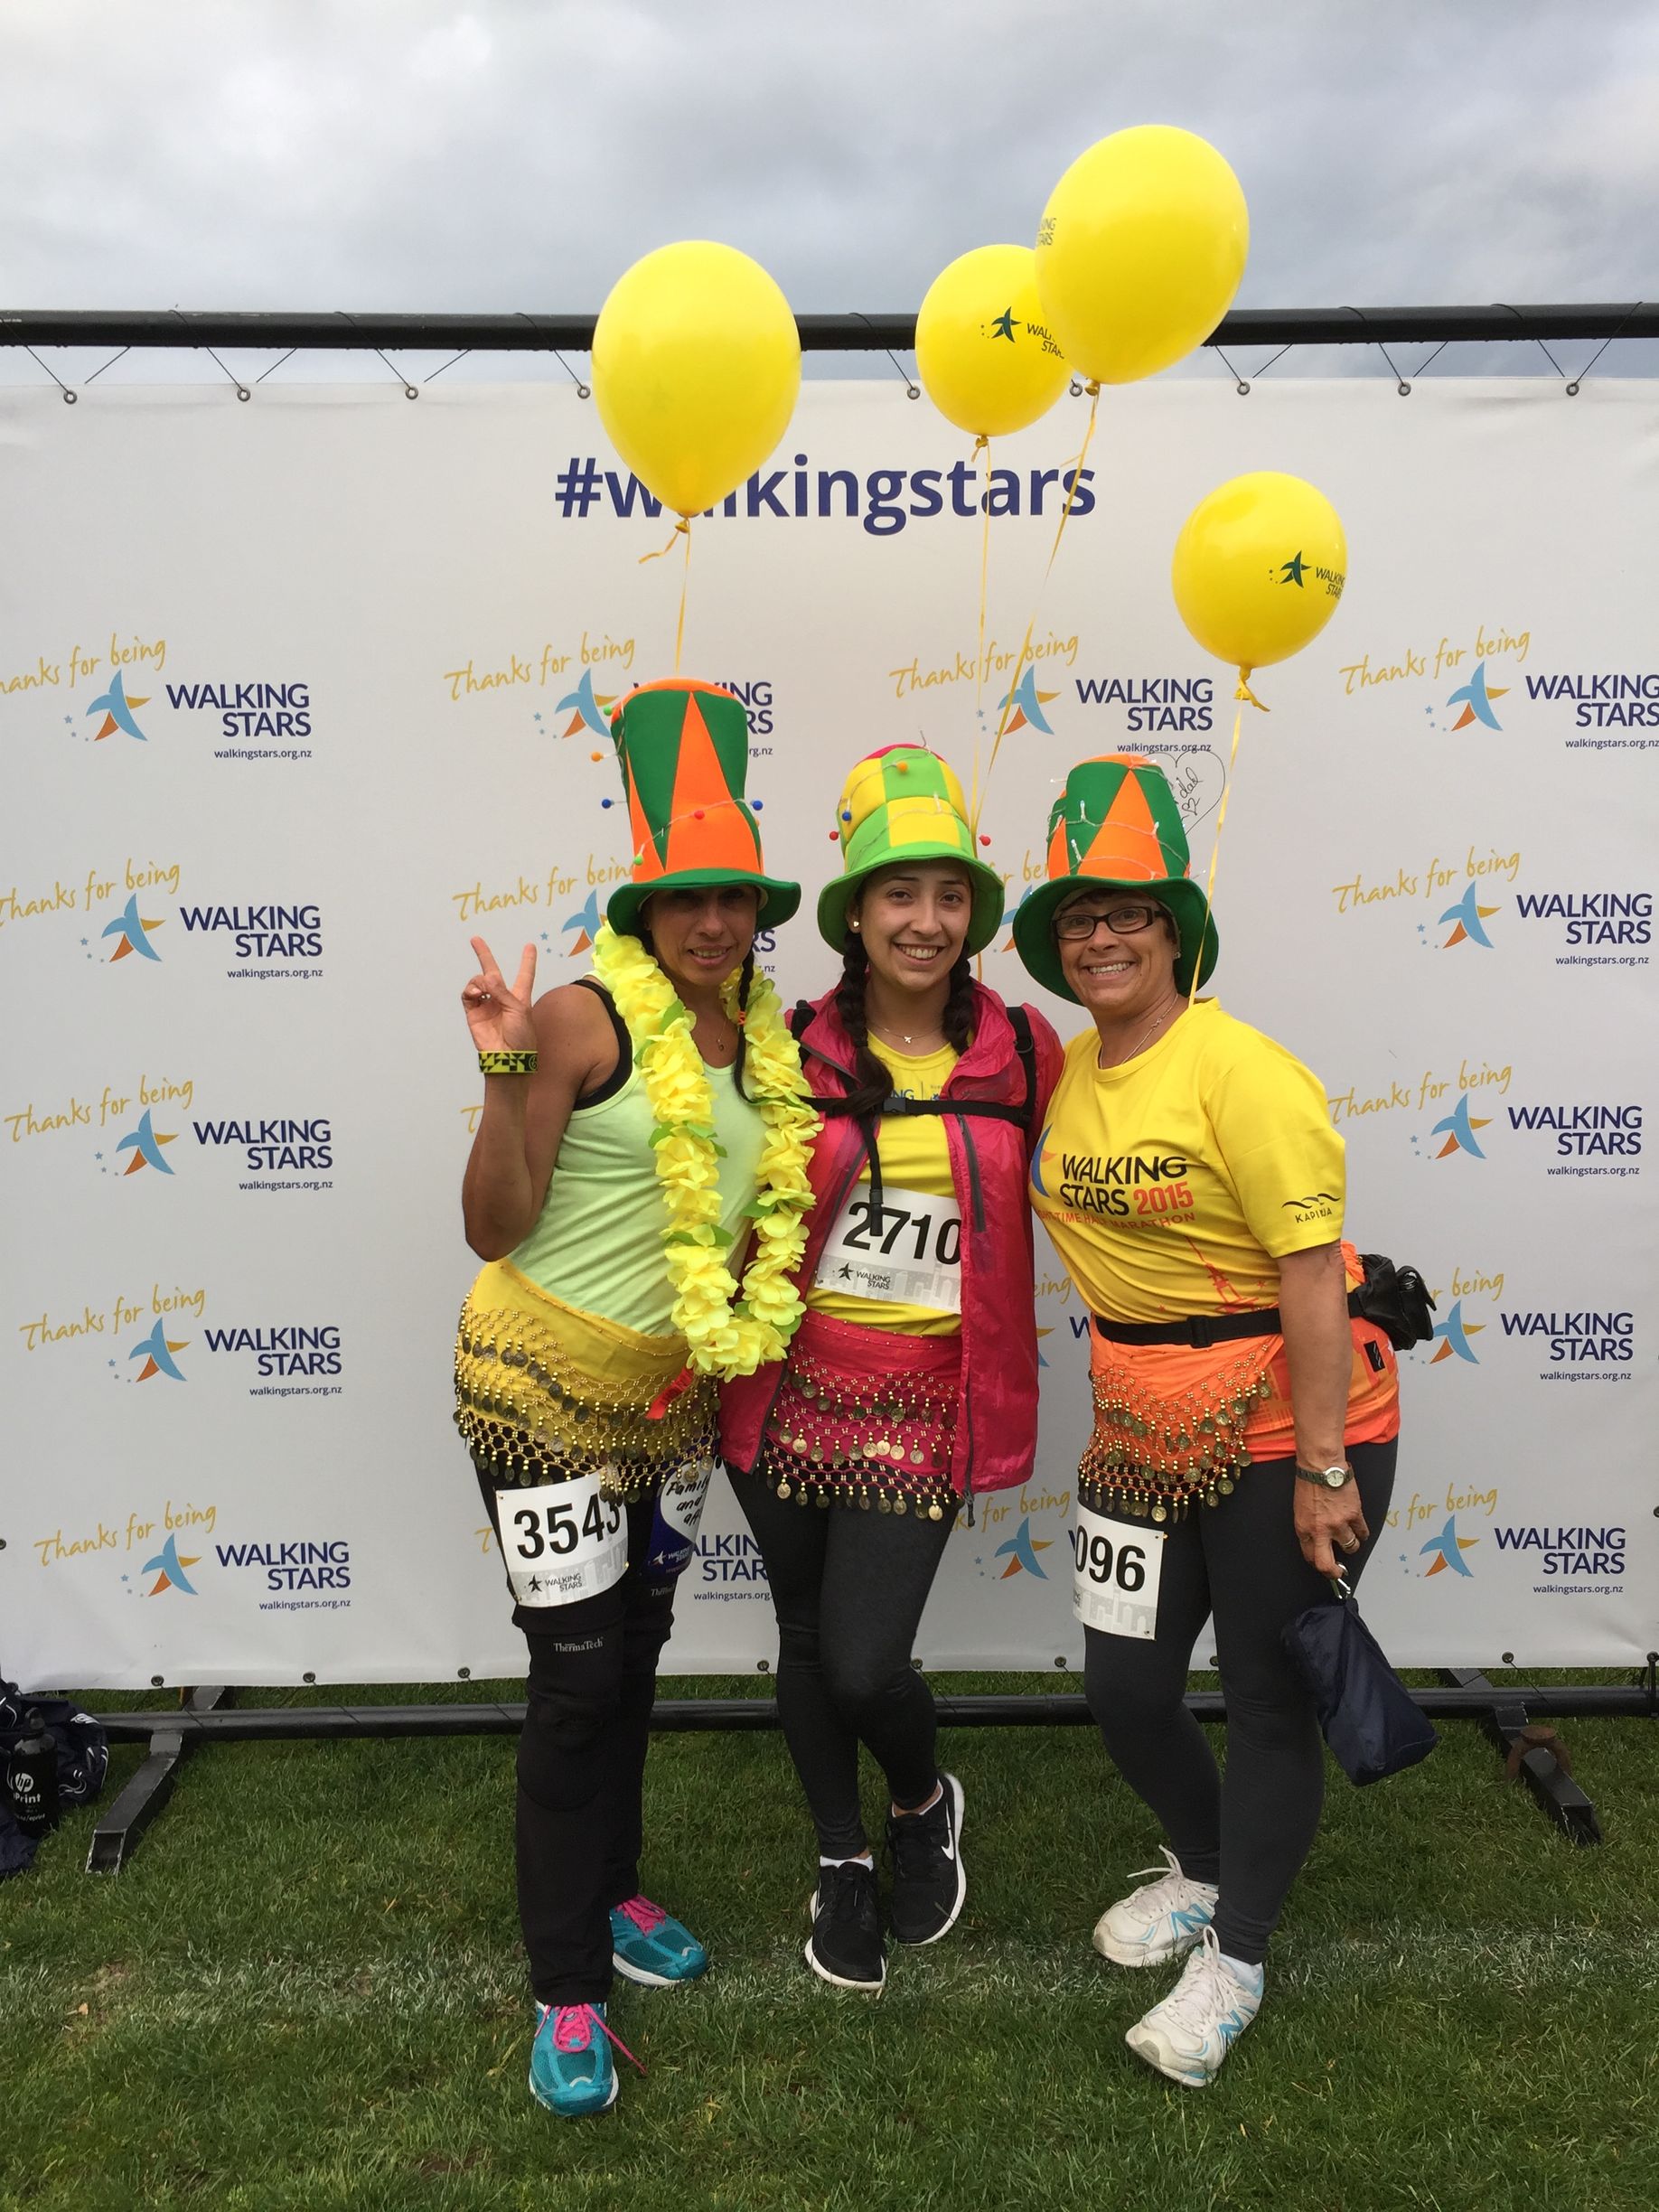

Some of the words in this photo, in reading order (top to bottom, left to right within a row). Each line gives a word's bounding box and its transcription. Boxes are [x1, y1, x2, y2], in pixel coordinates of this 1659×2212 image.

[555, 454, 1096, 536] #wkingstars
[0, 657, 60, 694] anks
[70, 644, 101, 688] for
[110, 633, 166, 671] being
[443, 655, 531, 701] Thanks
[539, 643, 573, 687] for
[580, 632, 635, 670] being
[889, 659, 975, 698] Thanks
[983, 641, 1016, 683] for
[1339, 649, 1426, 695] Thanks
[1434, 637, 1467, 680] for
[1475, 625, 1530, 662] being
[165, 683, 309, 709] WALKING
[1075, 679, 1213, 704] WALKING
[1525, 675, 1659, 699] WALKING
[223, 712, 311, 737] STARS
[1128, 707, 1213, 731] STARS
[1576, 702, 1659, 726] STARS
[214, 749, 312, 760] walkingstars.org.nz
[1117, 744, 1211, 754] walkingstars.org.nz
[1566, 738, 1659, 750] walkingstars.org.nz
[85, 868, 117, 911] for
[126, 858, 180, 895] being
[1332, 868, 1418, 914] Thanks
[1425, 858, 1457, 898] for
[1466, 846, 1521, 882] being
[452, 878, 538, 922] Thanks
[547, 866, 578, 906] for
[1516, 894, 1652, 918] WALKING
[180, 905, 321, 931] WALKING
[1566, 921, 1651, 944] STARS
[236, 933, 323, 957] STARS
[1556, 956, 1649, 967] walkingstars.org.nz
[228, 969, 323, 979] walkingstars.org.nz
[1418, 1071, 1450, 1110] for
[1458, 1060, 1512, 1094] being
[4, 1098, 90, 1142] Thanks
[99, 1086, 131, 1127] for
[139, 1074, 193, 1110] being
[1508, 1106, 1642, 1129] WALKING
[192, 1120, 331, 1145] WALKING
[1557, 1132, 1641, 1156] STARS
[248, 1146, 333, 1170] STARS
[1062, 1154, 1187, 1185] WALKING
[1547, 1167, 1639, 1176] walkingstars.org.nz
[239, 1181, 333, 1191] walkingstars.org.nz
[1059, 1183, 1129, 1216] STARS
[1133, 1181, 1194, 1215] 2015
[842, 1201, 961, 1265] 2710
[857, 1271, 891, 1283] WALKING
[867, 1279, 890, 1290] STARS
[1451, 1267, 1504, 1301] being
[19, 1307, 104, 1351] Thanks
[113, 1296, 144, 1335] for
[152, 1284, 205, 1317] being
[1501, 1313, 1633, 1336] WALKING
[204, 1326, 340, 1352] WALKING
[1550, 1338, 1633, 1361] STARS
[258, 1352, 342, 1376] STARS
[1540, 1372, 1631, 1382] walkingstars.org.nz
[249, 1387, 342, 1397] walkingstars.org.nz
[981, 1495, 1012, 1532] for
[1020, 1485, 1071, 1518] being
[1406, 1493, 1438, 1531] for
[1446, 1483, 1497, 1516] being
[33, 1523, 117, 1567] Thanks
[126, 1513, 155, 1551] for
[164, 1501, 217, 1533] being
[1495, 1528, 1626, 1550] WALKING
[216, 1542, 349, 1567] WALKING
[1075, 1525, 1146, 1591] 096
[1542, 1552, 1625, 1574] STARS
[268, 1566, 351, 1590] STARS
[545, 1572, 582, 1587] WALKING
[702, 1559, 768, 1581] STAR
[559, 1581, 583, 1592] STARS
[694, 1592, 772, 1602] walkingstars.org.
[1533, 1585, 1623, 1595] walkingstars.org.nz
[259, 1600, 351, 1611] walkingstars.org.nz
[14, 1792, 41, 1804] Print
